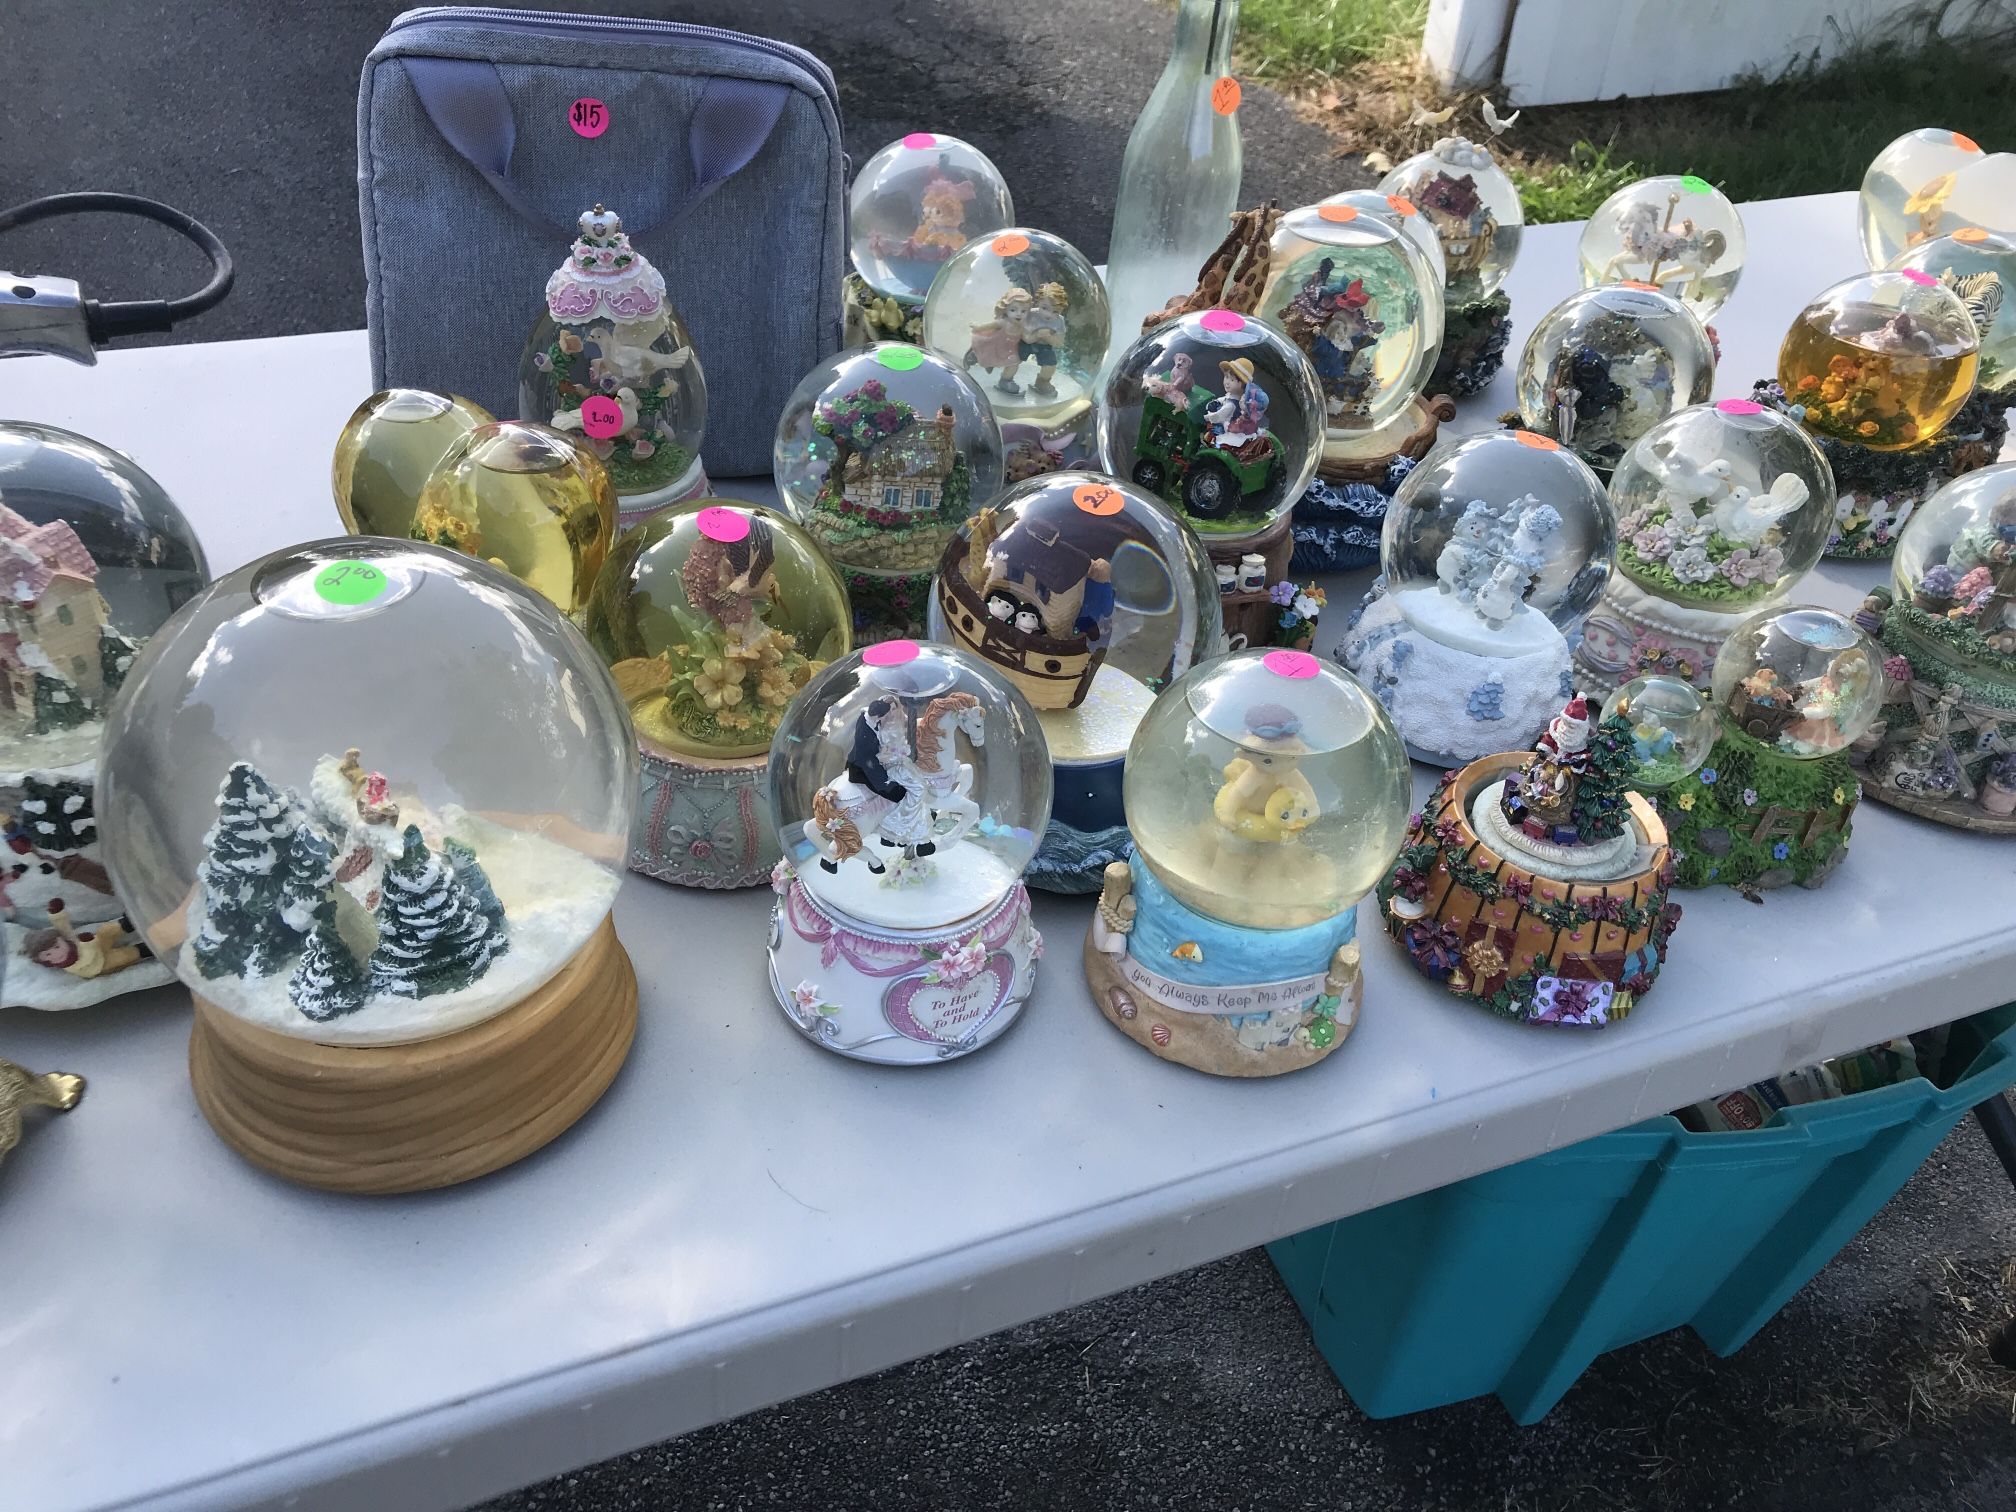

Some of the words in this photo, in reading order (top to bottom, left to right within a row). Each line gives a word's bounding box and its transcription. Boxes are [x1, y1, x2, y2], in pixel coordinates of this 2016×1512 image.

[573, 102, 603, 128] $15
[931, 1000, 946, 1011] To
[949, 990, 980, 1007] Have
[1157, 983, 1209, 1007] Always
[1217, 993, 1251, 1008] Keep
[1258, 991, 1278, 1004] Me
[933, 1019, 947, 1029] To
[952, 1008, 980, 1024] Hold
[943, 1003, 966, 1017] and
